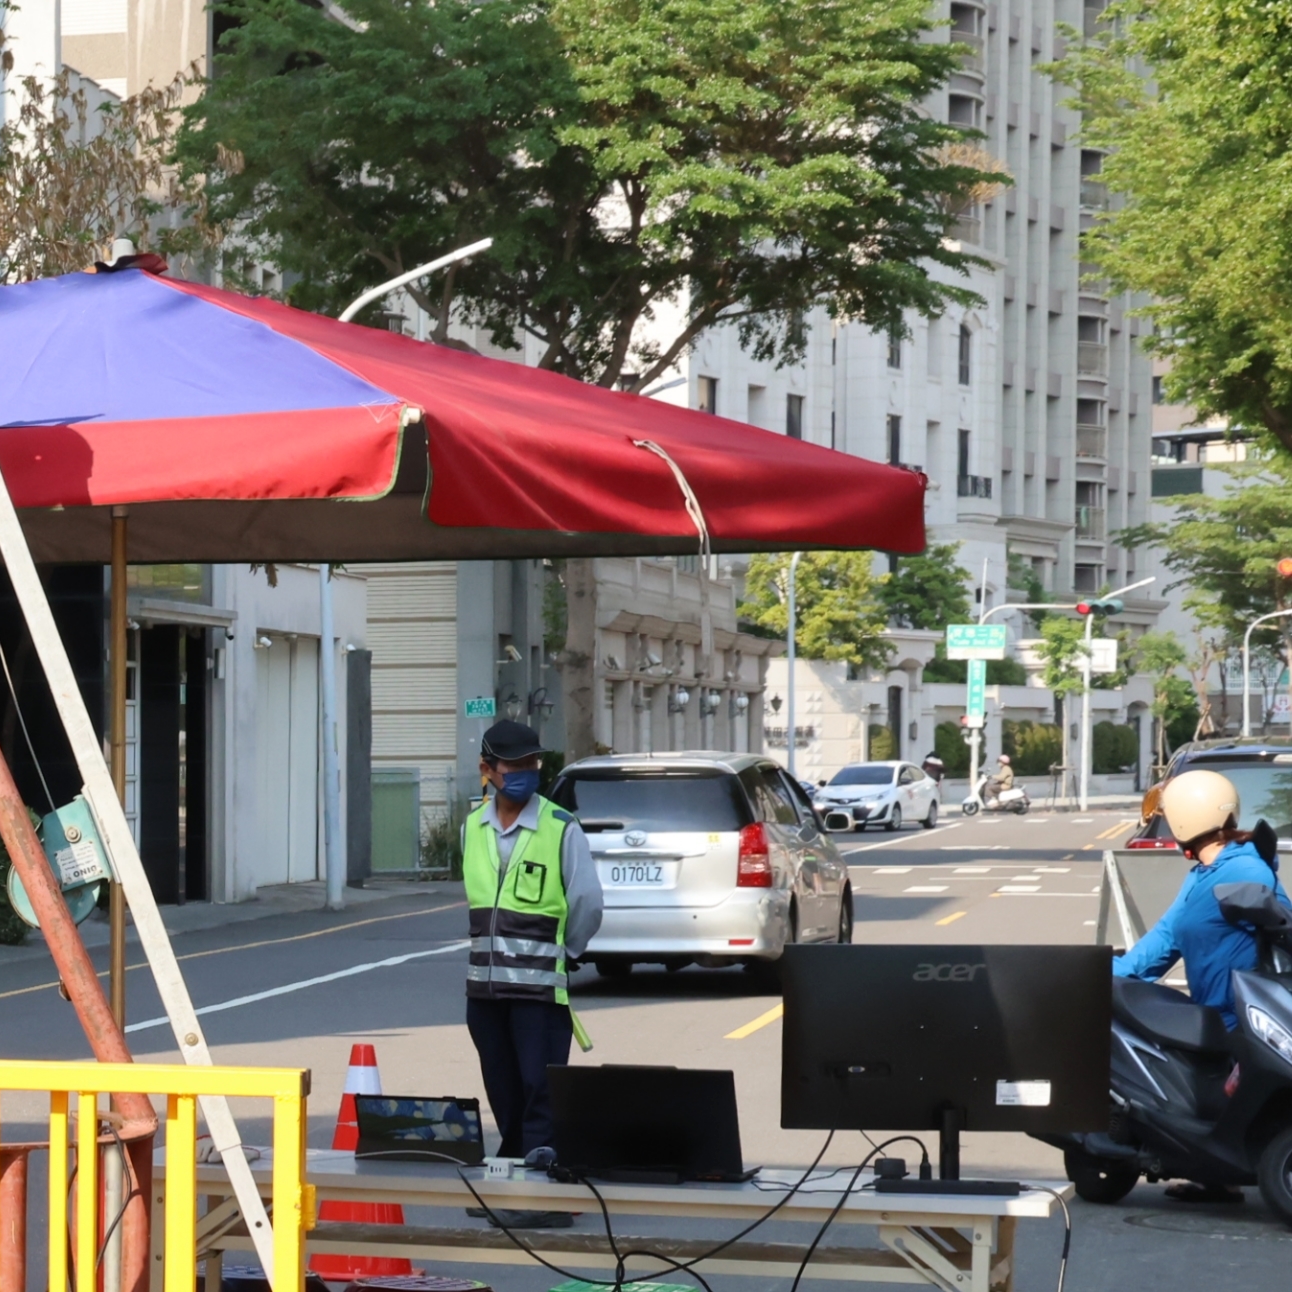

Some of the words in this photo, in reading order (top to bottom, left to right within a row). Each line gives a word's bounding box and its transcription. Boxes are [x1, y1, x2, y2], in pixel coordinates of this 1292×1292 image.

[73, 865, 97, 878] DINO
[611, 866, 662, 882] 0170-LZ
[913, 963, 987, 982] acer
